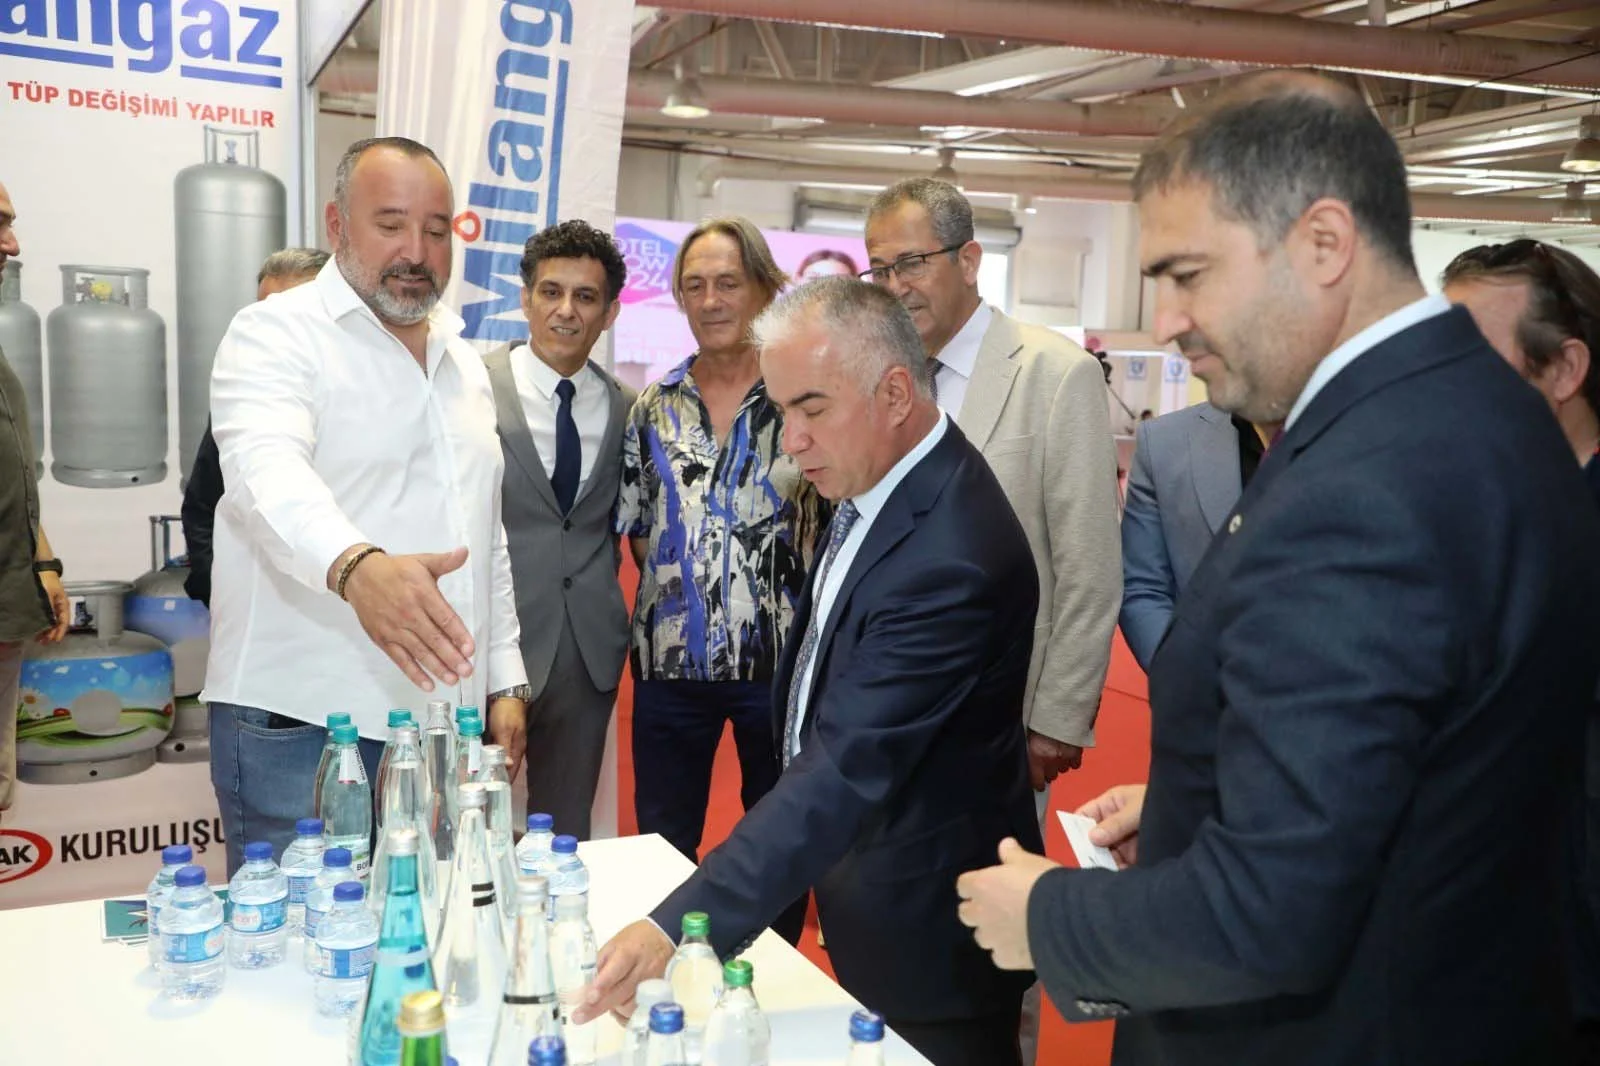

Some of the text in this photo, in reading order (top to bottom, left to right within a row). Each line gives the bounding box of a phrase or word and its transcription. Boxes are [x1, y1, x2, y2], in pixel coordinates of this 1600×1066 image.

[7, 80, 275, 128] TÜP DEĞİŞİMİ YAPILIR
[626, 271, 669, 290] 24
